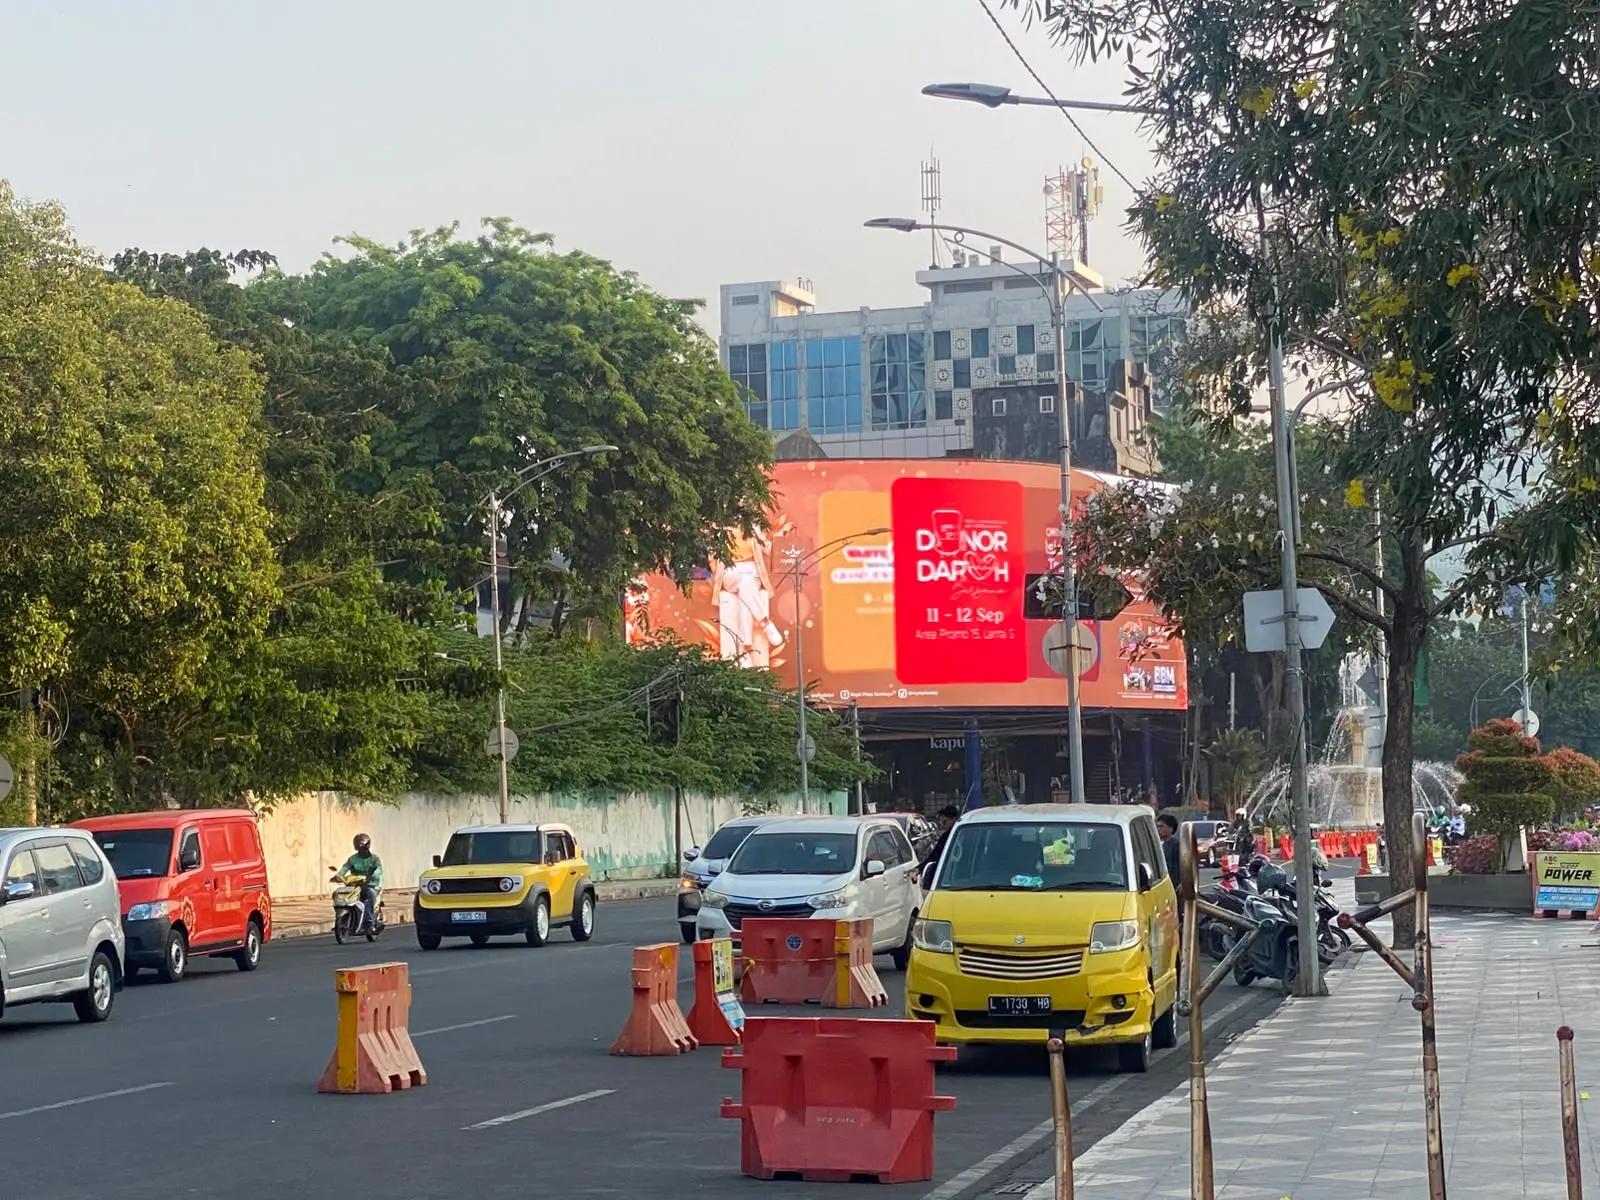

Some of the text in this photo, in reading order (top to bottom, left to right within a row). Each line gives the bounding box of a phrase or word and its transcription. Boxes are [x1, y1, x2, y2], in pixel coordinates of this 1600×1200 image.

[915, 529, 1008, 552] DNOR
[916, 560, 1009, 582] DARH
[956, 607, 972, 622] 12
[976, 608, 1005, 625] Sep
[1153, 666, 1176, 684] BBM
[1544, 869, 1592, 882] POWER
[990, 998, 997, 1009] L
